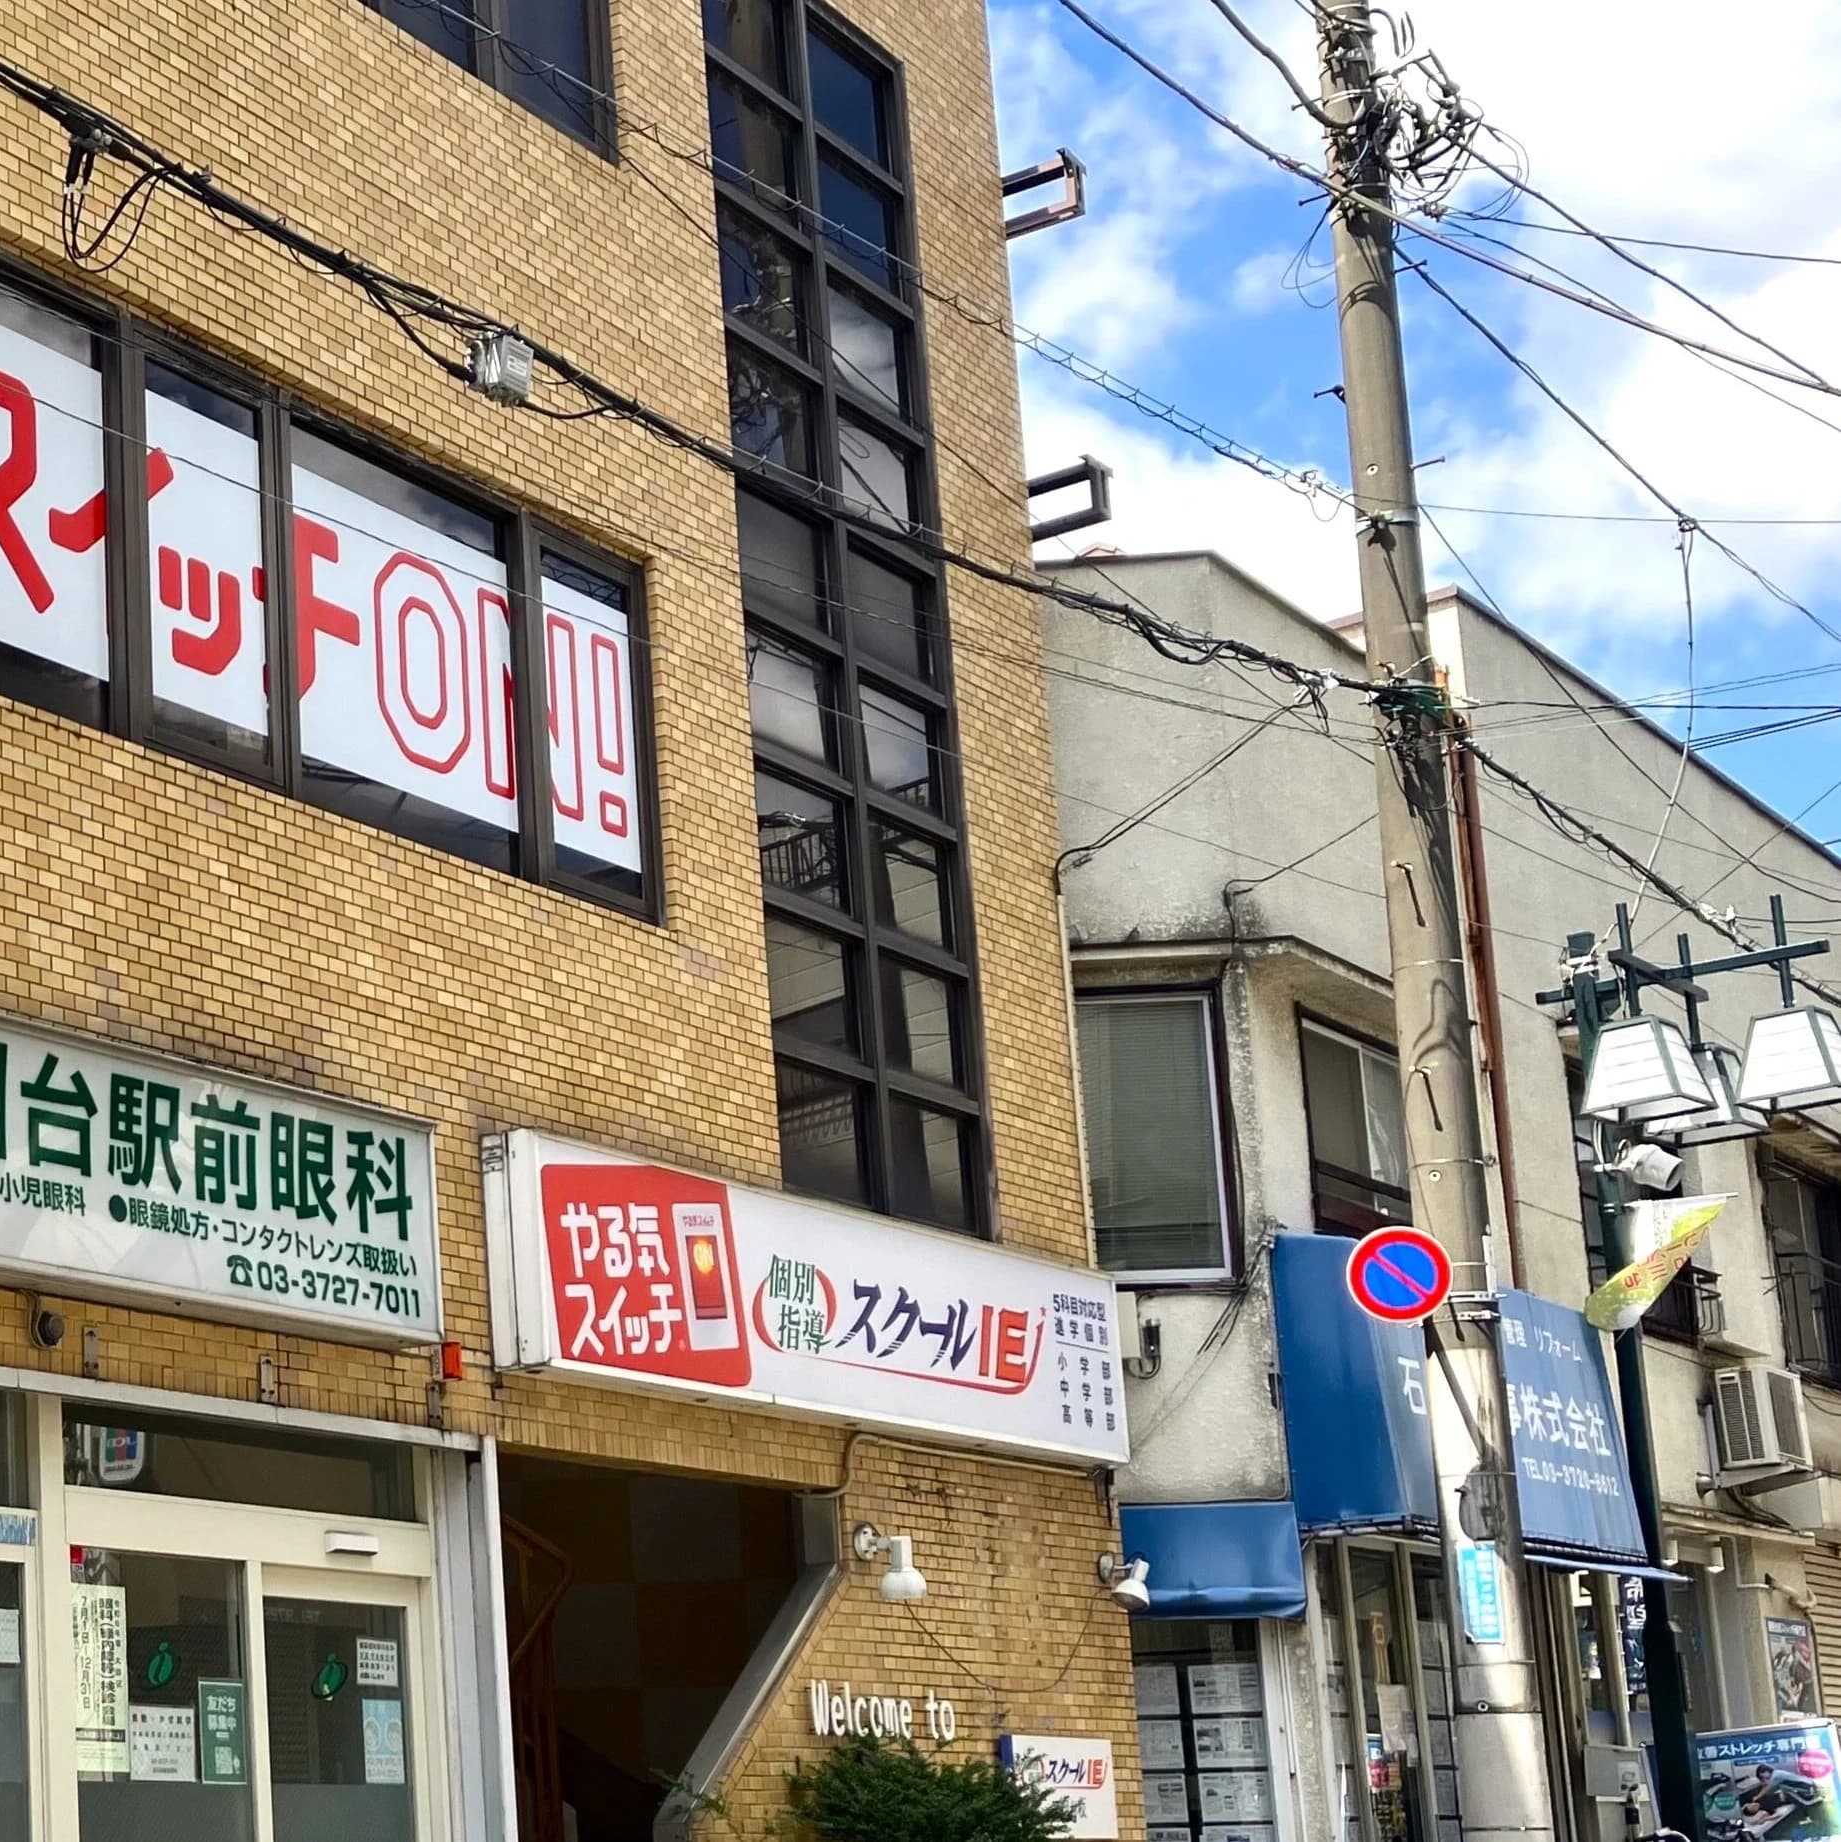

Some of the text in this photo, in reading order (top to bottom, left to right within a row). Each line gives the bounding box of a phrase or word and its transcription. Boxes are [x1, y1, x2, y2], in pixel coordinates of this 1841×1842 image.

[560, 1202, 670, 1278] やる気
[258, 1261, 421, 1318] 03-3727-7011
[769, 1254, 816, 1304] 個別
[565, 1283, 682, 1358] スイッチ
[778, 1303, 831, 1355] 指導
[810, 1679, 956, 1741] Welcome to
